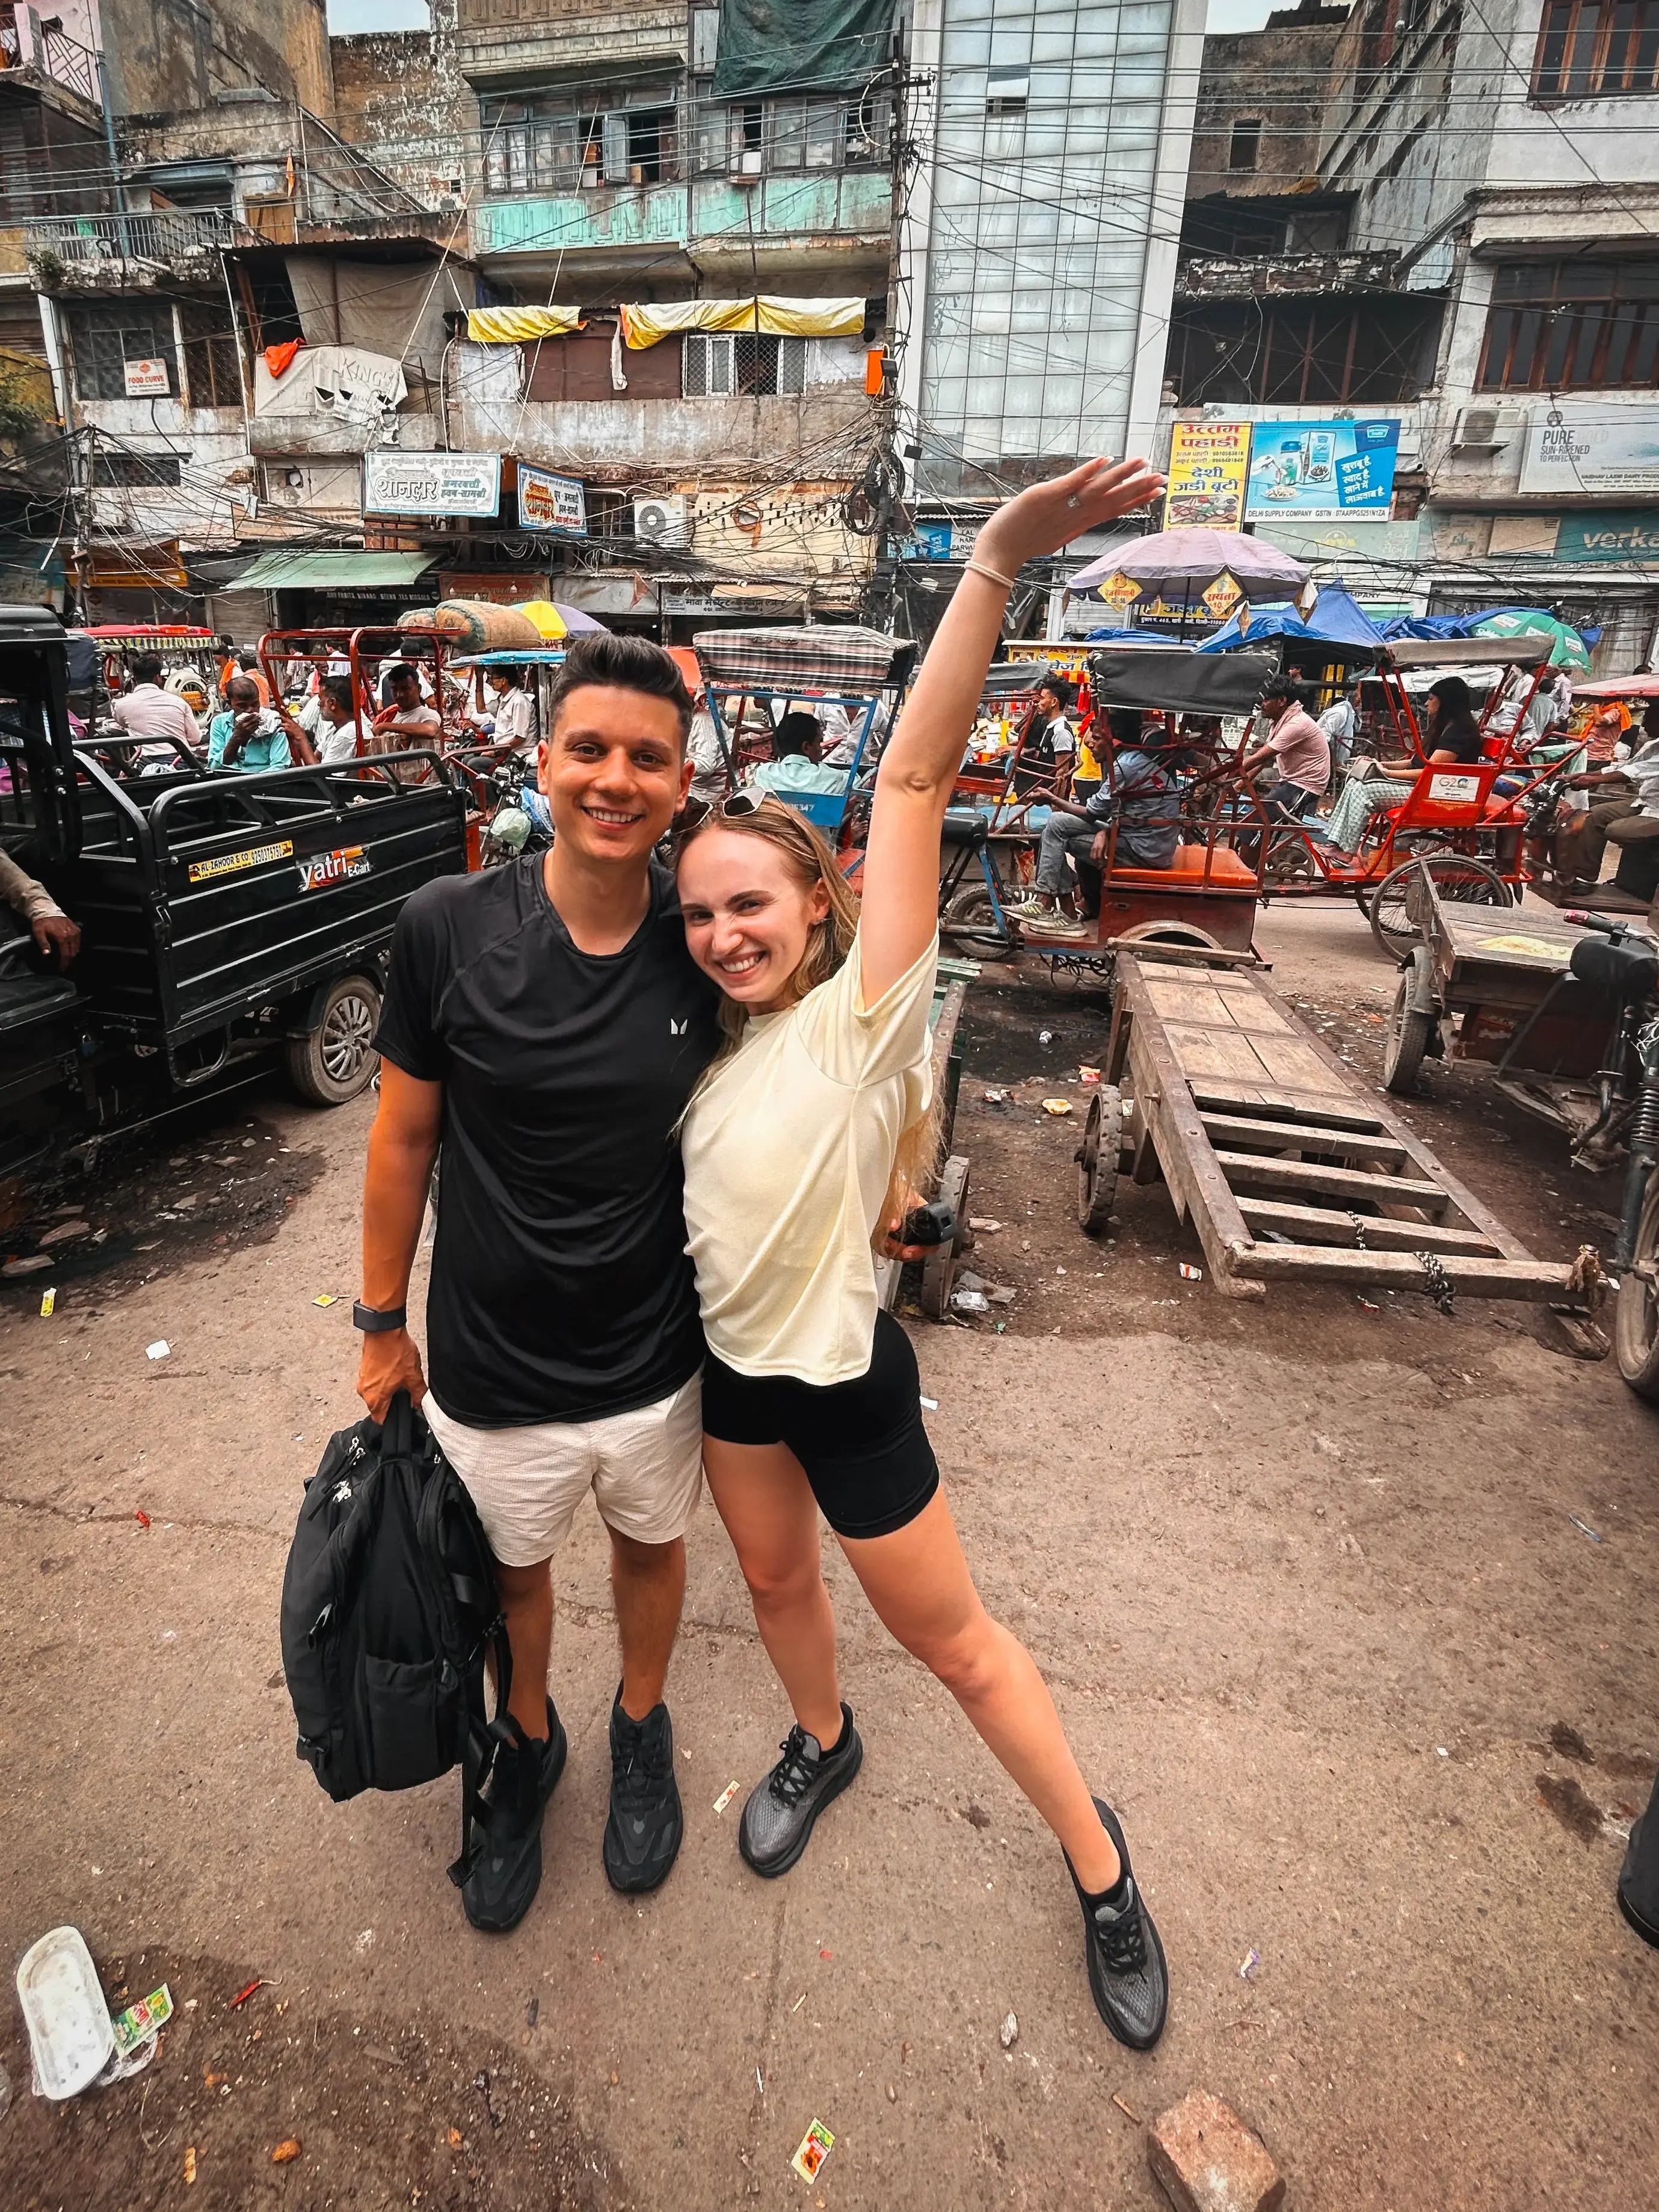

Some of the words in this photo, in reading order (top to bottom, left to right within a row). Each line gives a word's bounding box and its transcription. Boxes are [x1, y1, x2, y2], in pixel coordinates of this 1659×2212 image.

[1542, 430, 1575, 445] PURE
[1540, 445, 1590, 455] SUN-RIPENED
[1192, 466, 1223, 478] देशी
[377, 479, 439, 503] शानदार
[1211, 479, 1239, 493] बूटी
[1207, 592, 1236, 601] रायता
[1050, 660, 1076, 671] वेज
[1439, 777, 1469, 789] G20
[235, 852, 240, 863] &
[298, 851, 347, 891] yatri
[347, 861, 370, 877] E-Cart
